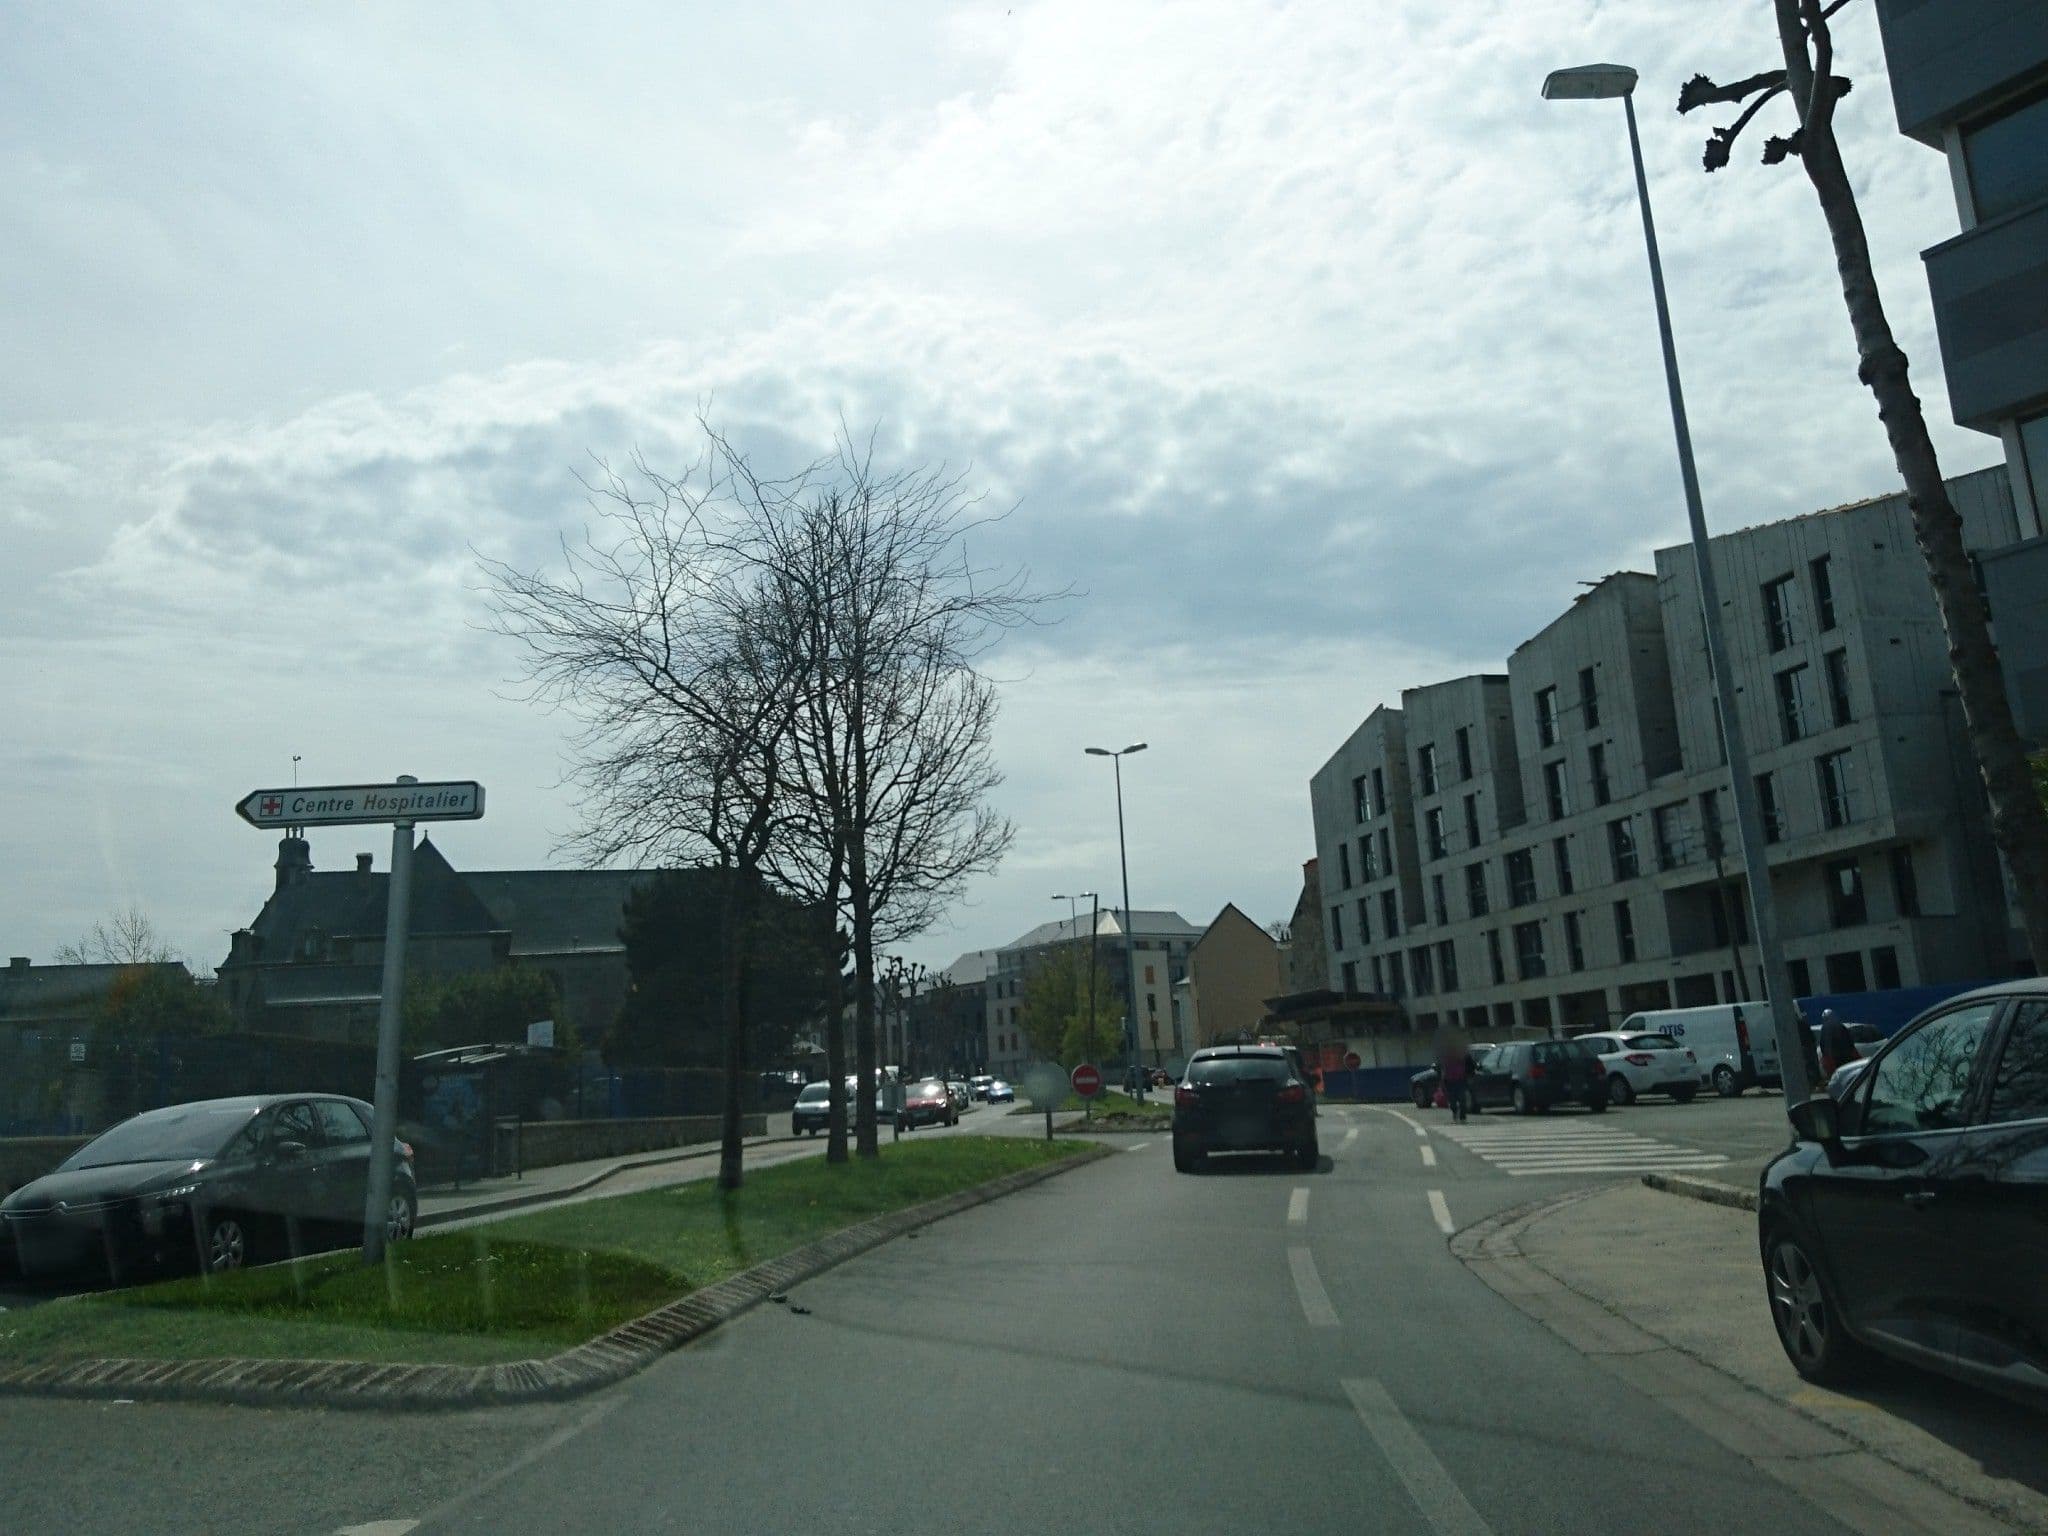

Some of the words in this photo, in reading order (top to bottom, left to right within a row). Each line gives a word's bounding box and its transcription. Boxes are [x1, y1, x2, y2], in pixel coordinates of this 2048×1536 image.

[292, 797, 354, 813] Centre
[363, 791, 468, 814] Hospitalier
[1659, 1024, 1685, 1036] OTIS
